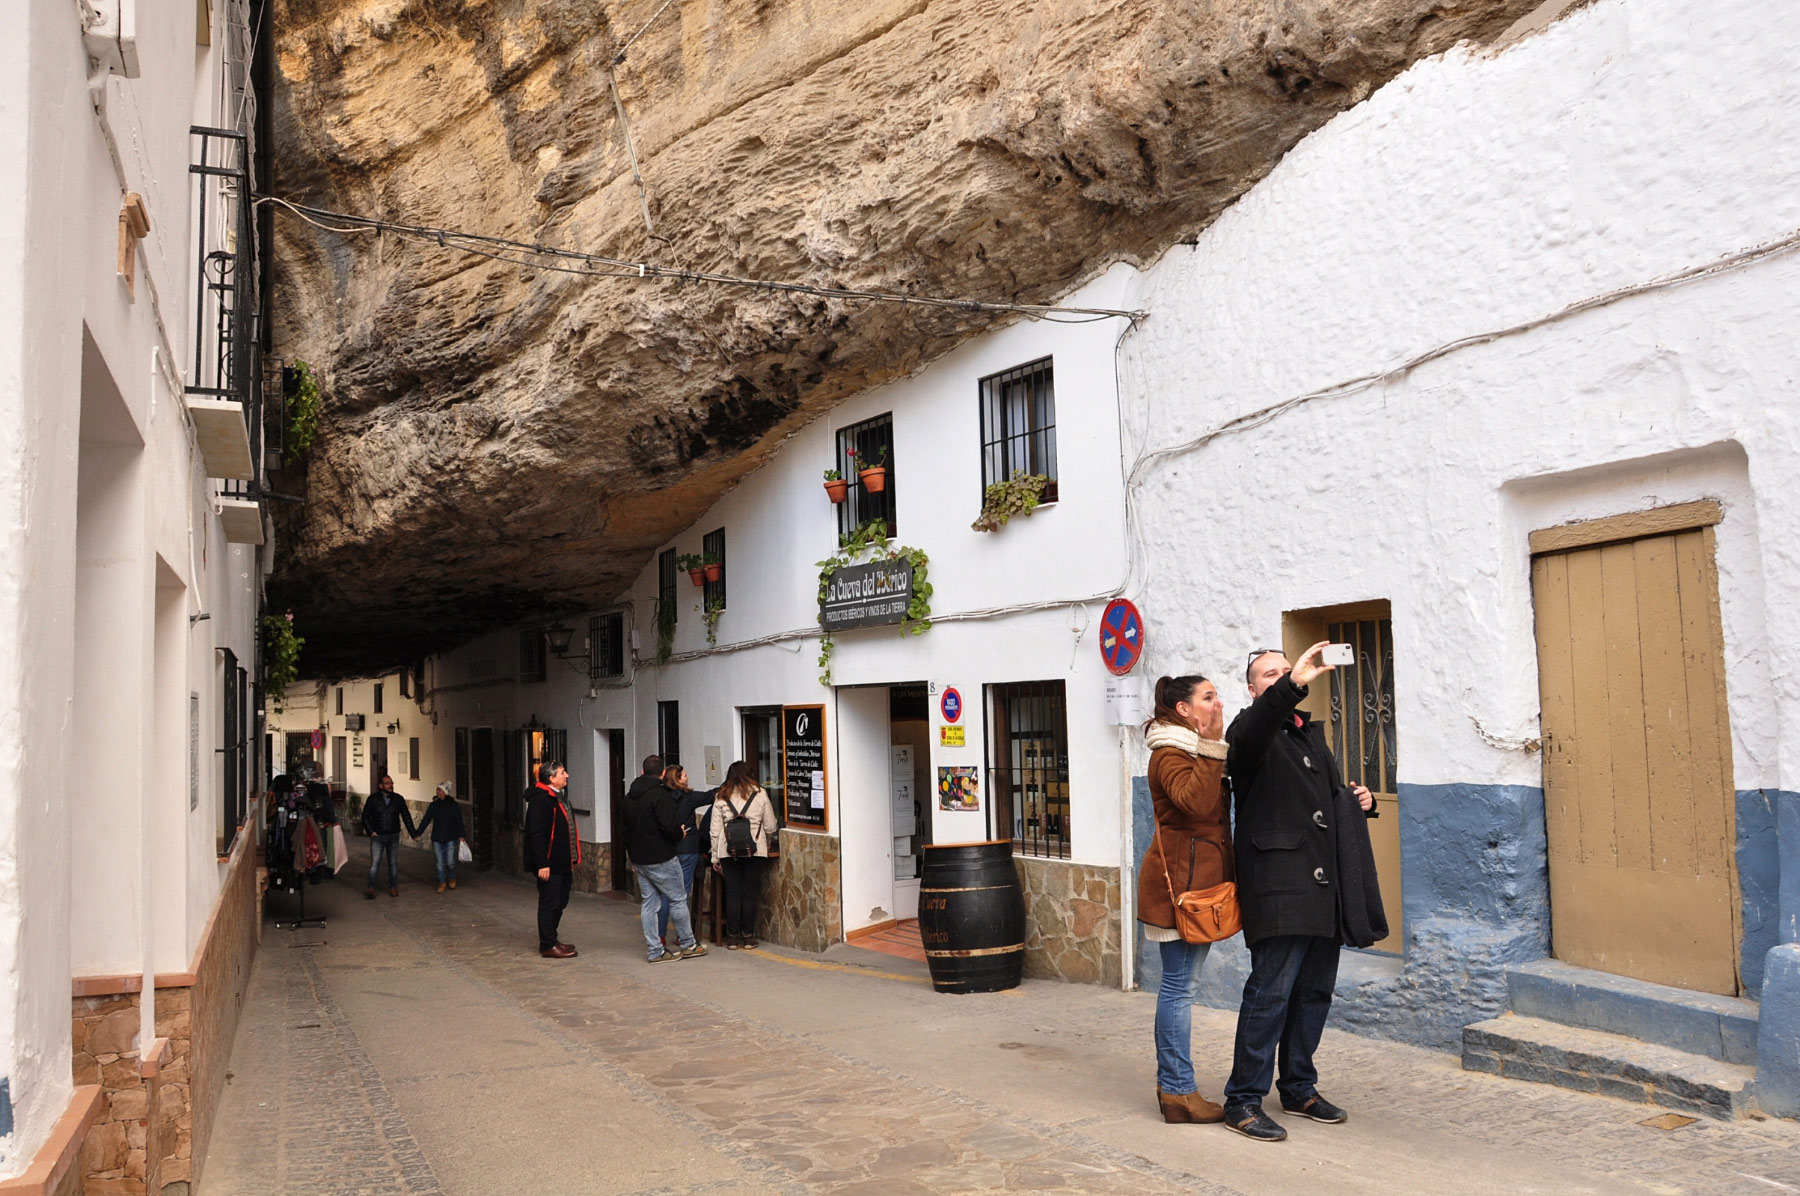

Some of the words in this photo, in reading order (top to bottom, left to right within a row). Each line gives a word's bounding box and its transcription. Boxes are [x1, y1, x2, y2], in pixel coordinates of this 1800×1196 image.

[837, 578, 861, 600] Cueva
[862, 572, 875, 596] del
[826, 608, 848, 622] PRODUCTOS
[868, 606, 880, 617] VINOS
[880, 604, 886, 615] DE
[886, 603, 892, 614] LA
[892, 601, 906, 613] TIERRA
[930, 682, 936, 693] 8
